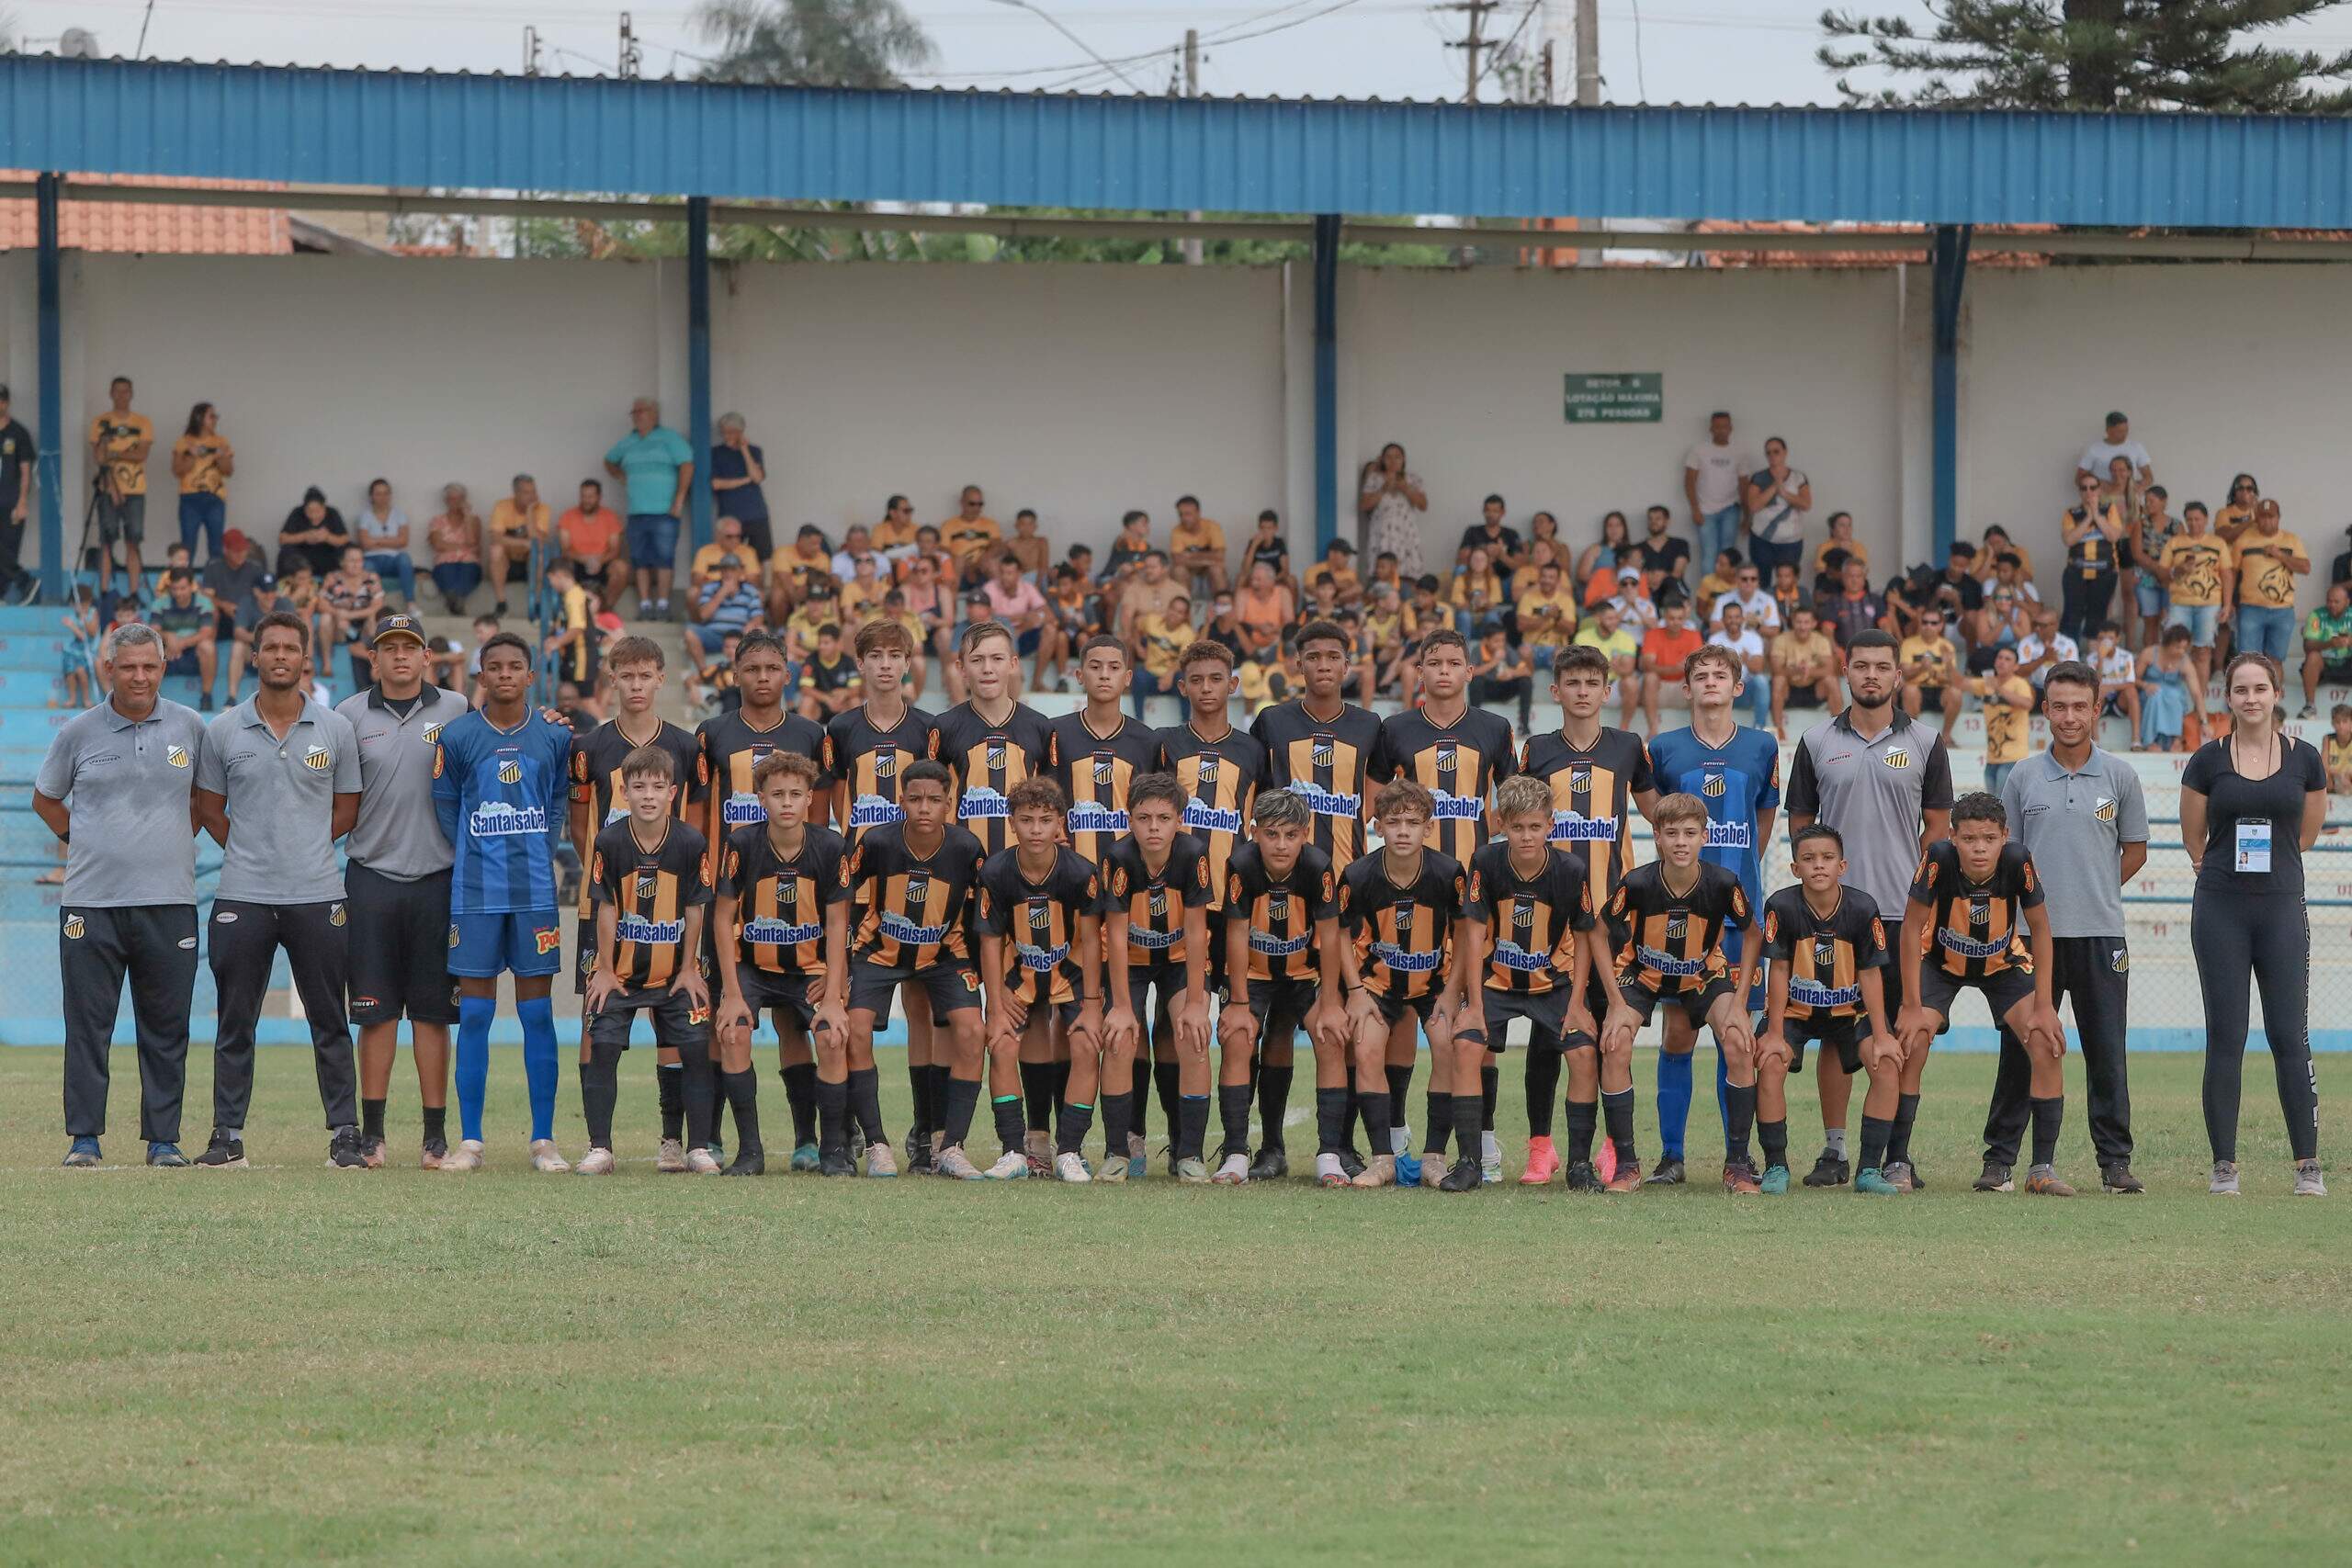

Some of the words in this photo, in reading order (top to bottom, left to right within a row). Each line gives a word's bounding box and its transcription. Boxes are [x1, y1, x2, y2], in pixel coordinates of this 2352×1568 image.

[1601, 408, 1650, 417] PESSOAS
[1963, 719, 1980, 731] 13
[724, 803, 768, 823] Santais
[850, 803, 907, 824] Santaisa
[959, 796, 1010, 817] Santais
[1301, 794, 1357, 816] taisabel
[746, 920, 822, 942] Santaisabel
[881, 920, 944, 943] antaisab
[1128, 928, 1184, 947] antaisab
[1939, 929, 2012, 956] Santaisabel
[1022, 946, 1069, 970] ntaisbel
[1496, 951, 1552, 970] ntaisabe
